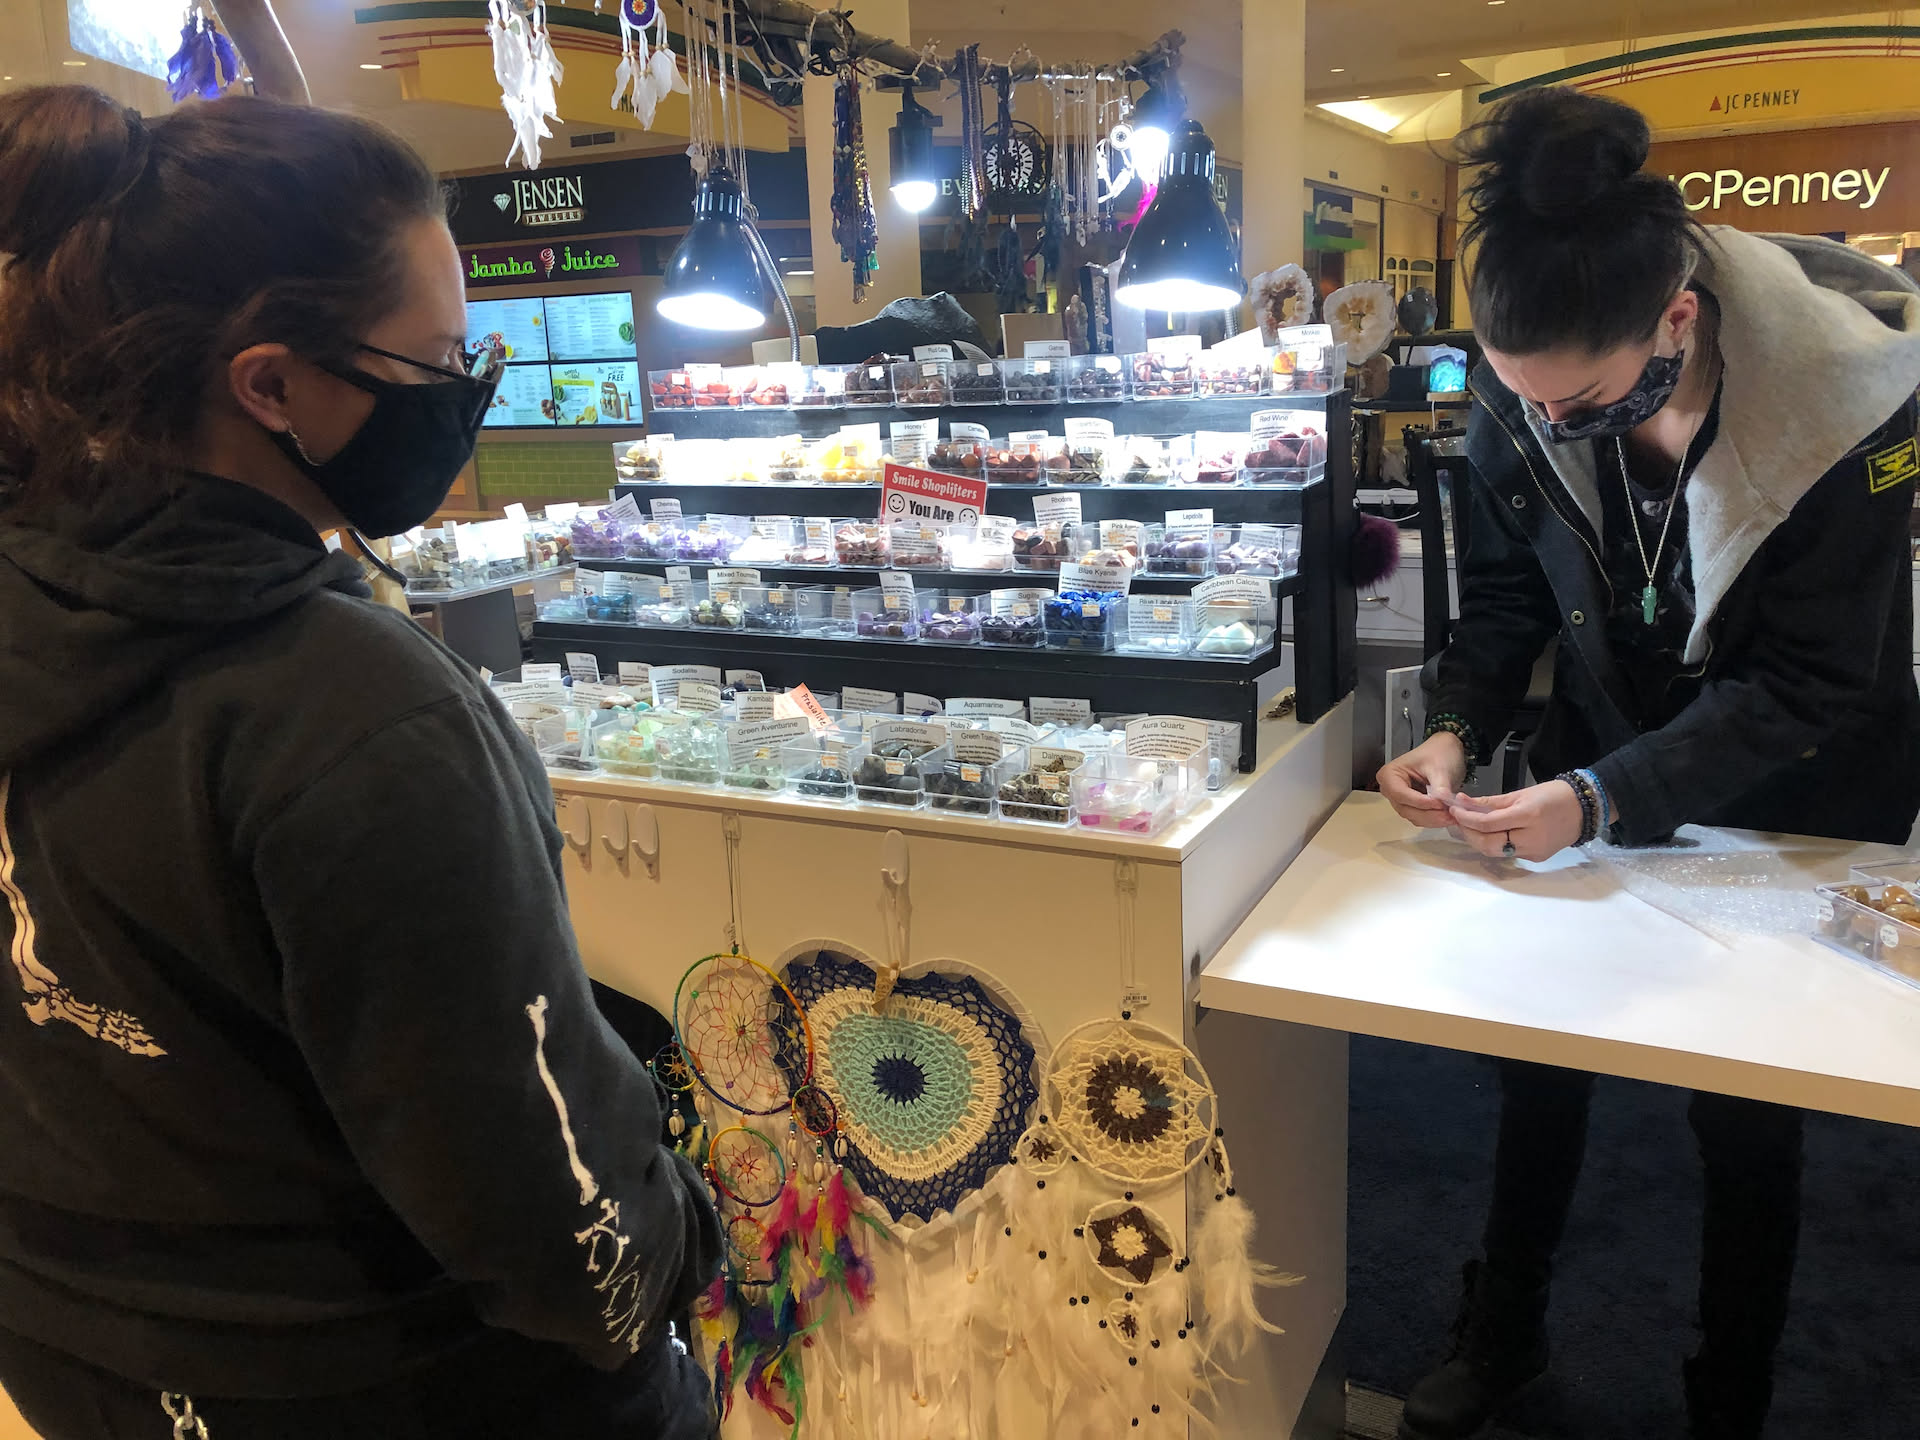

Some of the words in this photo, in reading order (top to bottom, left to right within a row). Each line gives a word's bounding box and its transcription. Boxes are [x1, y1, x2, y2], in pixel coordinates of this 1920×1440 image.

[1667, 166, 1891, 212] CPenney
[512, 175, 584, 224] JENSEN
[525, 211, 582, 225] JEWELERS
[607, 372, 625, 382] FREE
[903, 423, 923, 432] Honey
[891, 471, 921, 490] Smile
[921, 478, 979, 500] Shoplifters
[909, 499, 932, 519] You
[933, 505, 955, 523] Are
[1200, 578, 1235, 593] Caribbean
[671, 667, 698, 675] Sodalite
[963, 701, 1005, 711] Aquamarine
[737, 725, 760, 737] Green
[760, 721, 799, 733] Aventurine
[1141, 722, 1159, 730] Aura
[1160, 721, 1185, 731] Quartz
[960, 732, 981, 742] Green
